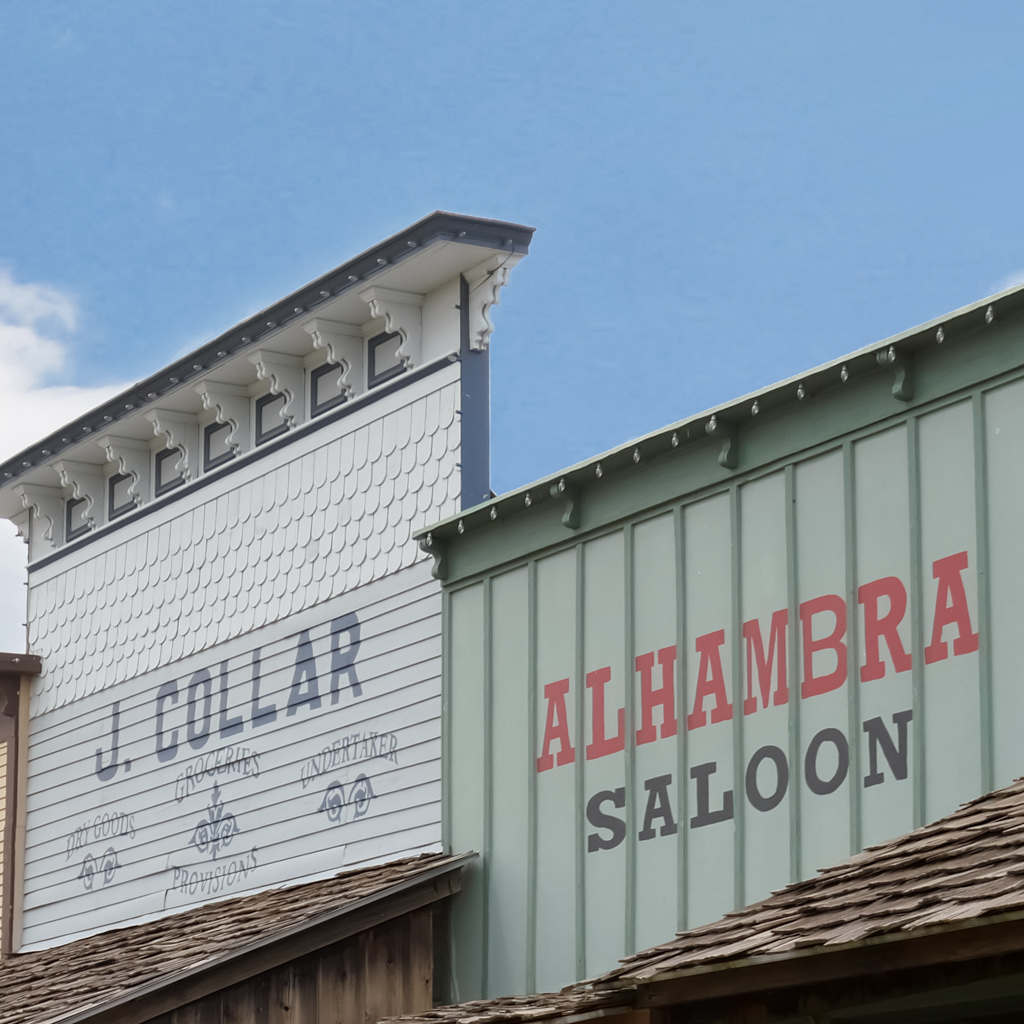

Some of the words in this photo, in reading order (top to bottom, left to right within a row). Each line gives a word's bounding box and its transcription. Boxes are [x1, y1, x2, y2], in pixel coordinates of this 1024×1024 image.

[537, 550, 979, 773] ALHAMBRA
[95, 701, 132, 782] J.
[154, 611, 363, 763] COLLAR
[175, 746, 261, 803] GROCERIES
[300, 731, 398, 790] UNDERTAKER
[586, 709, 913, 853] SALOON
[66, 817, 91, 862] DRY
[93, 811, 136, 840] GOODS
[171, 847, 260, 896] PROVISIONS
